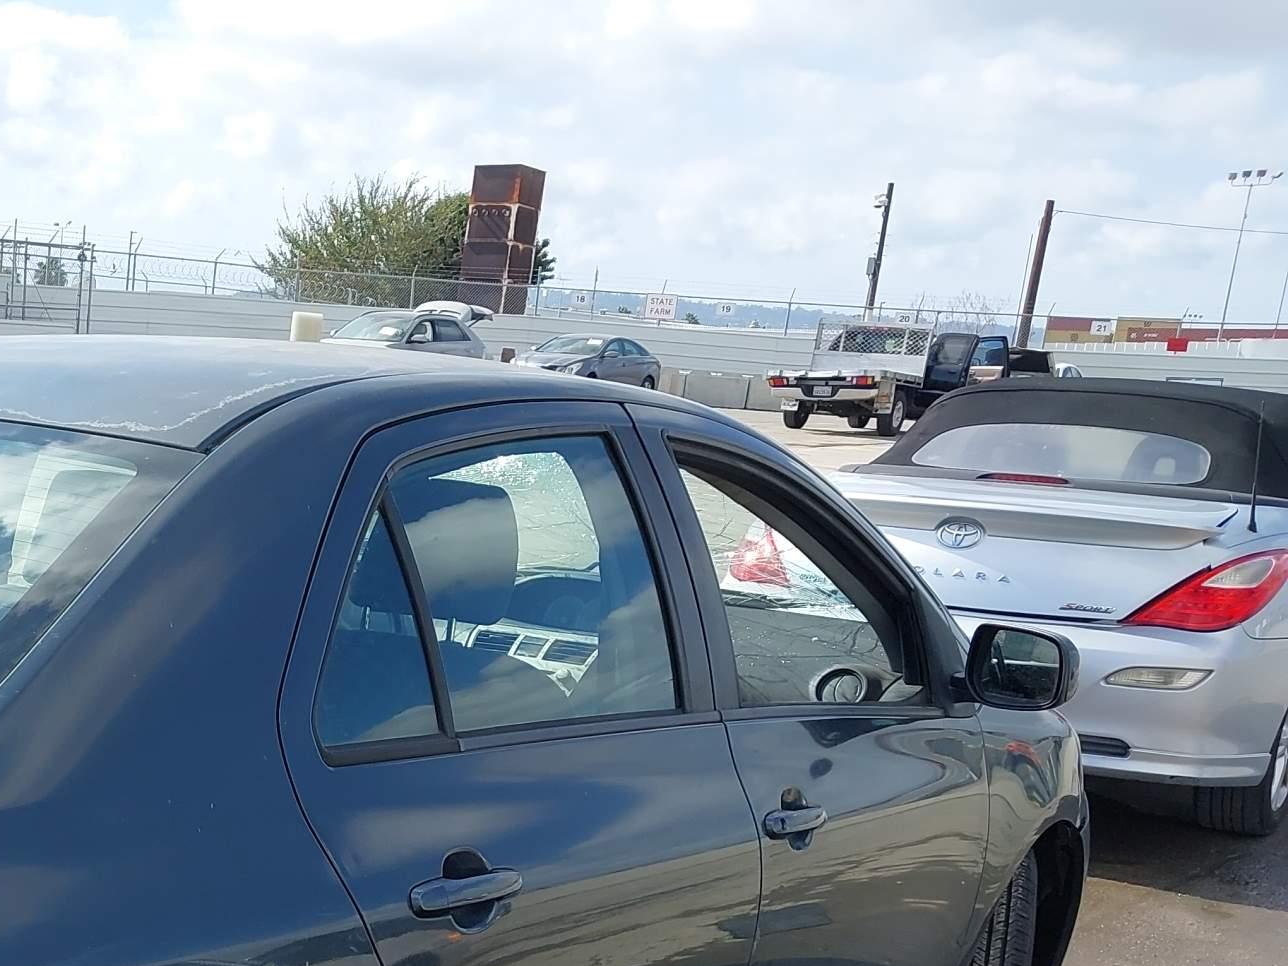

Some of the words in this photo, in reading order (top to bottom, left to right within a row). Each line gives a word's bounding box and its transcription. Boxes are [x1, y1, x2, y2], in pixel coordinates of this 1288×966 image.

[576, 295, 586, 303] 18
[650, 297, 674, 306] STATE
[649, 307, 671, 316] FARM
[721, 305, 732, 313] 19
[899, 315, 911, 323] 20
[1096, 324, 1107, 332] 21
